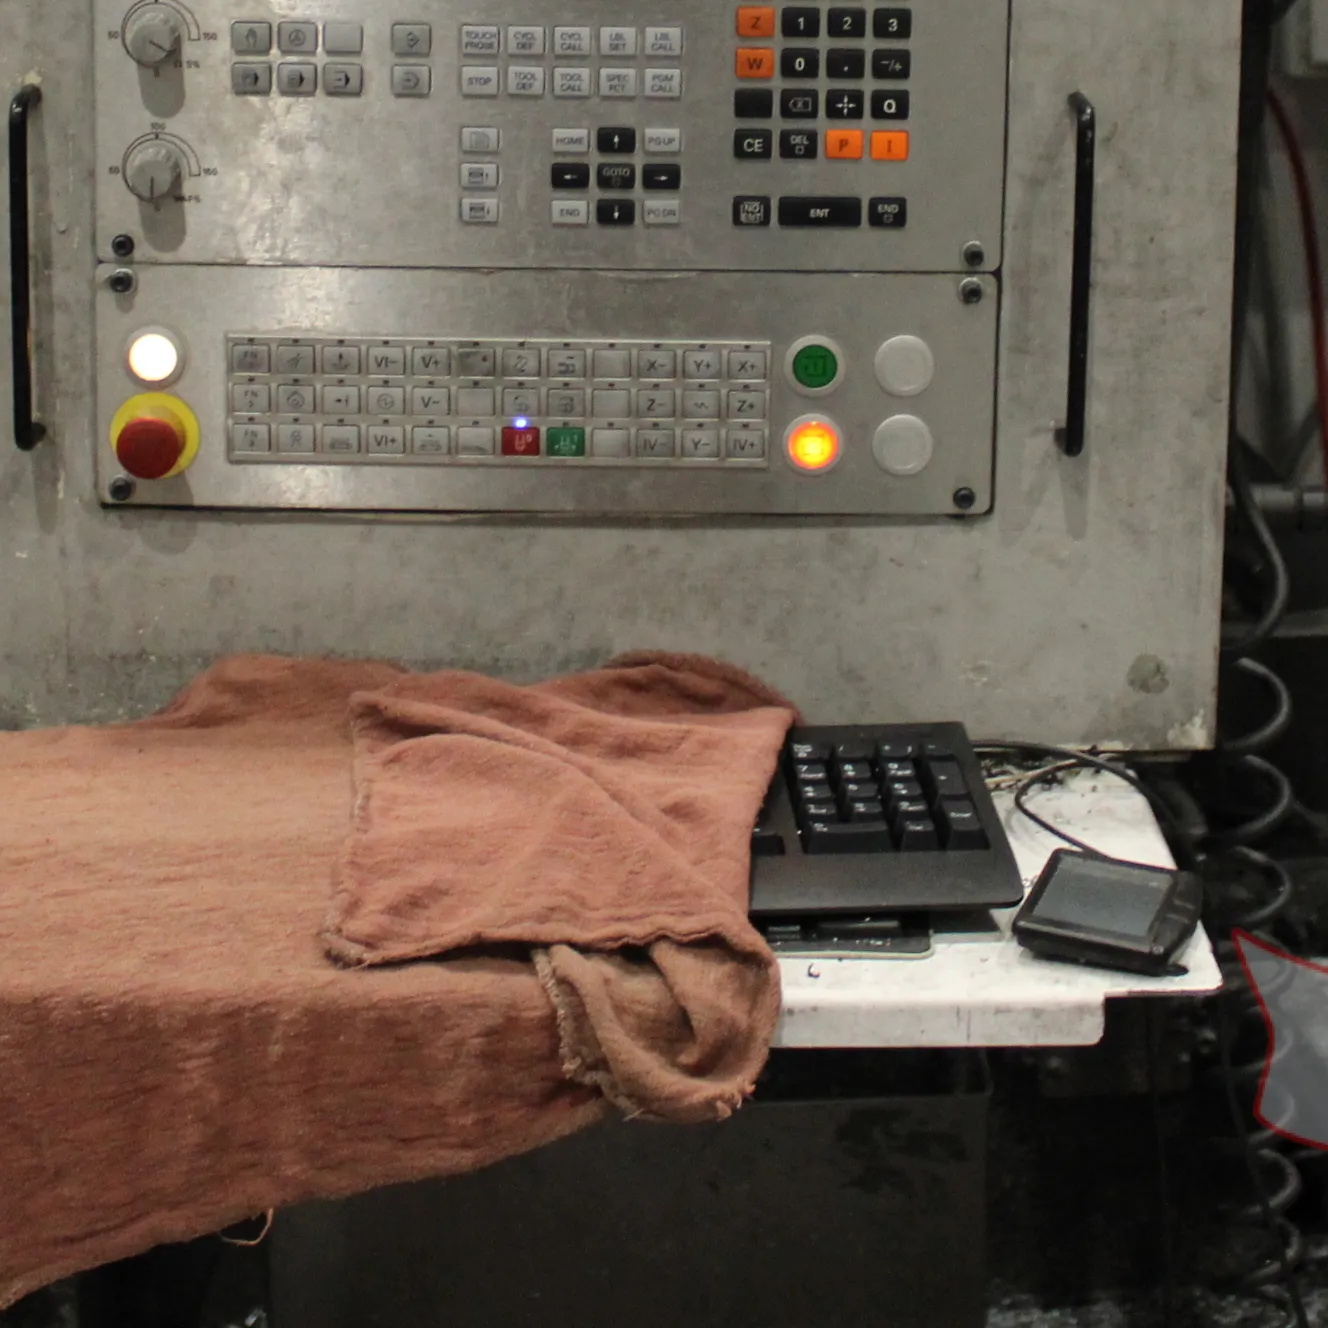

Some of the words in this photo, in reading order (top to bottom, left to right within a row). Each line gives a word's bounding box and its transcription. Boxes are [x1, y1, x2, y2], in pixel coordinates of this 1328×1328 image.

[750, 16, 760, 29] Z
[798, 17, 805, 31] 1
[843, 17, 852, 30] 2
[888, 18, 898, 31] 3
[560, 42, 583, 51] CALL
[747, 57, 764, 70] W
[795, 57, 805, 70] 0
[467, 77, 492, 86] STOP
[883, 99, 896, 113] Q
[555, 136, 584, 146] HOME
[743, 138, 764, 152] CE
[790, 135, 809, 145] DEL
[838, 138, 849, 152] P
[602, 168, 630, 177] GOTO
[559, 208, 580, 217] END
[809, 208, 830, 218] ENT
[877, 204, 899, 214] END
